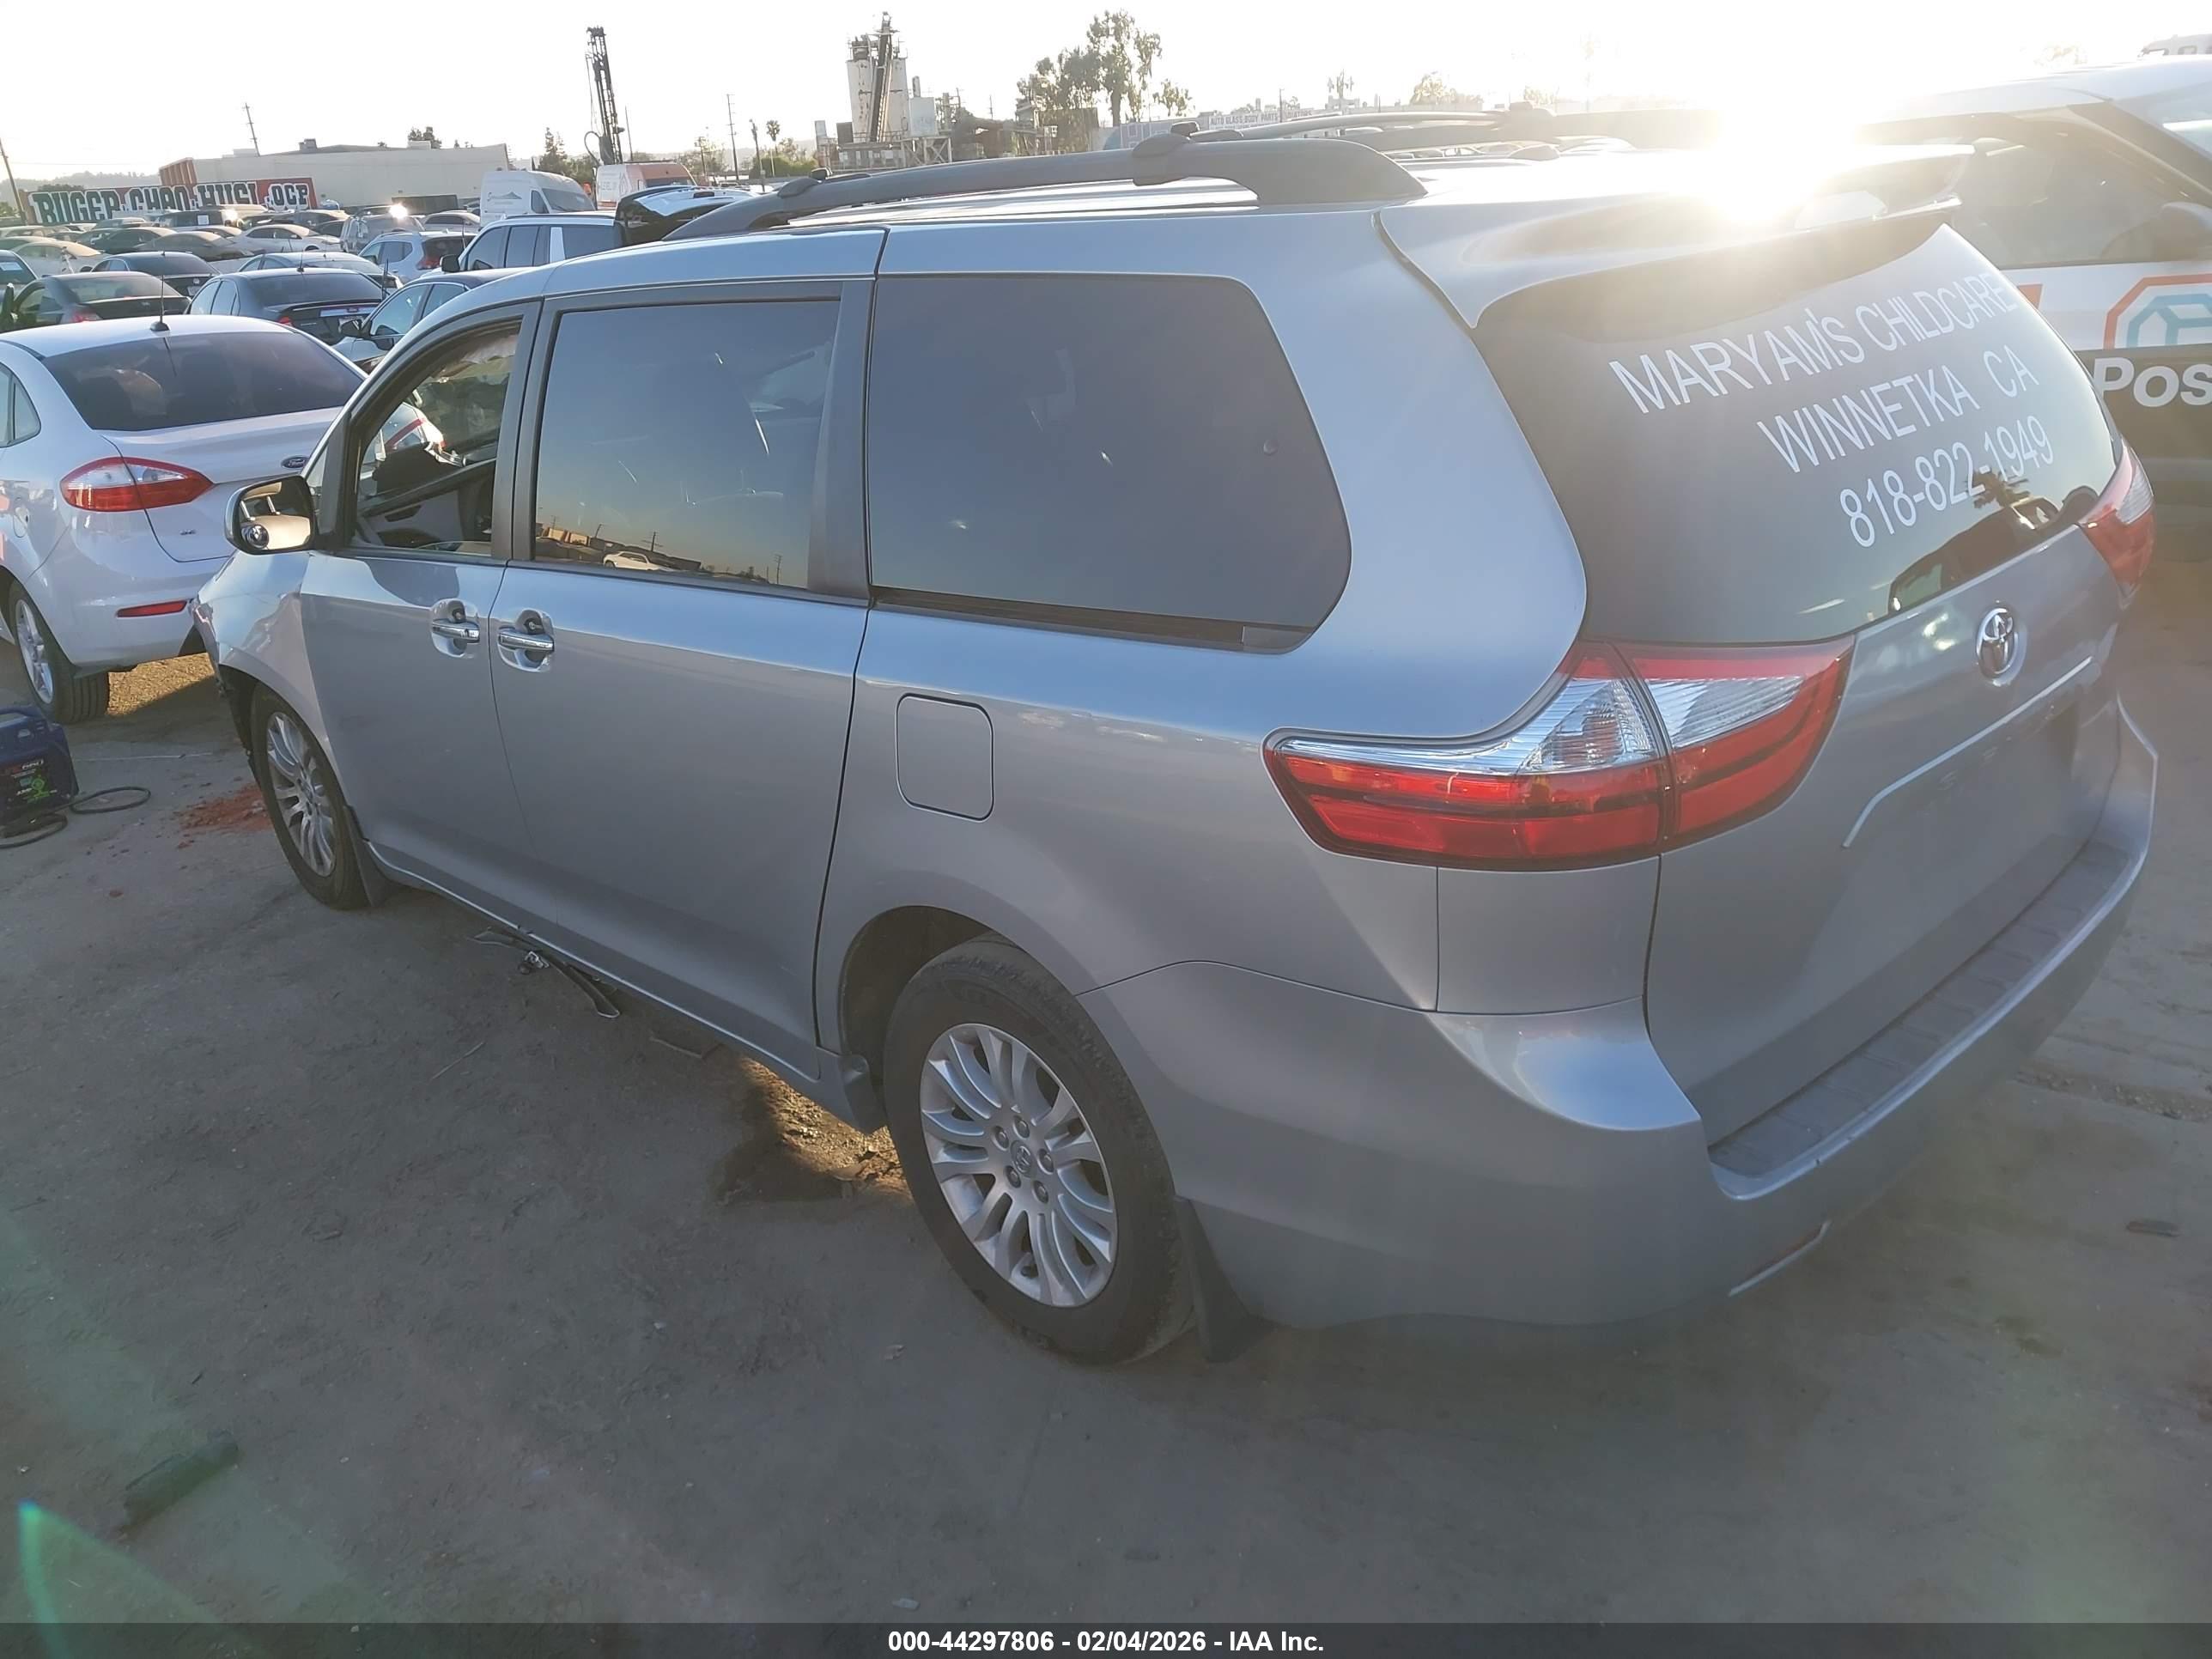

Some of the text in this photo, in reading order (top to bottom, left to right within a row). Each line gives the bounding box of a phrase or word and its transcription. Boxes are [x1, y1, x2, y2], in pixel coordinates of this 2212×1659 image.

[1609, 273, 2018, 414] MARYAM'S CHILDCARE
[1757, 344, 2039, 473] WINNETKA CA
[1839, 416, 2055, 548] 818-822-1949
